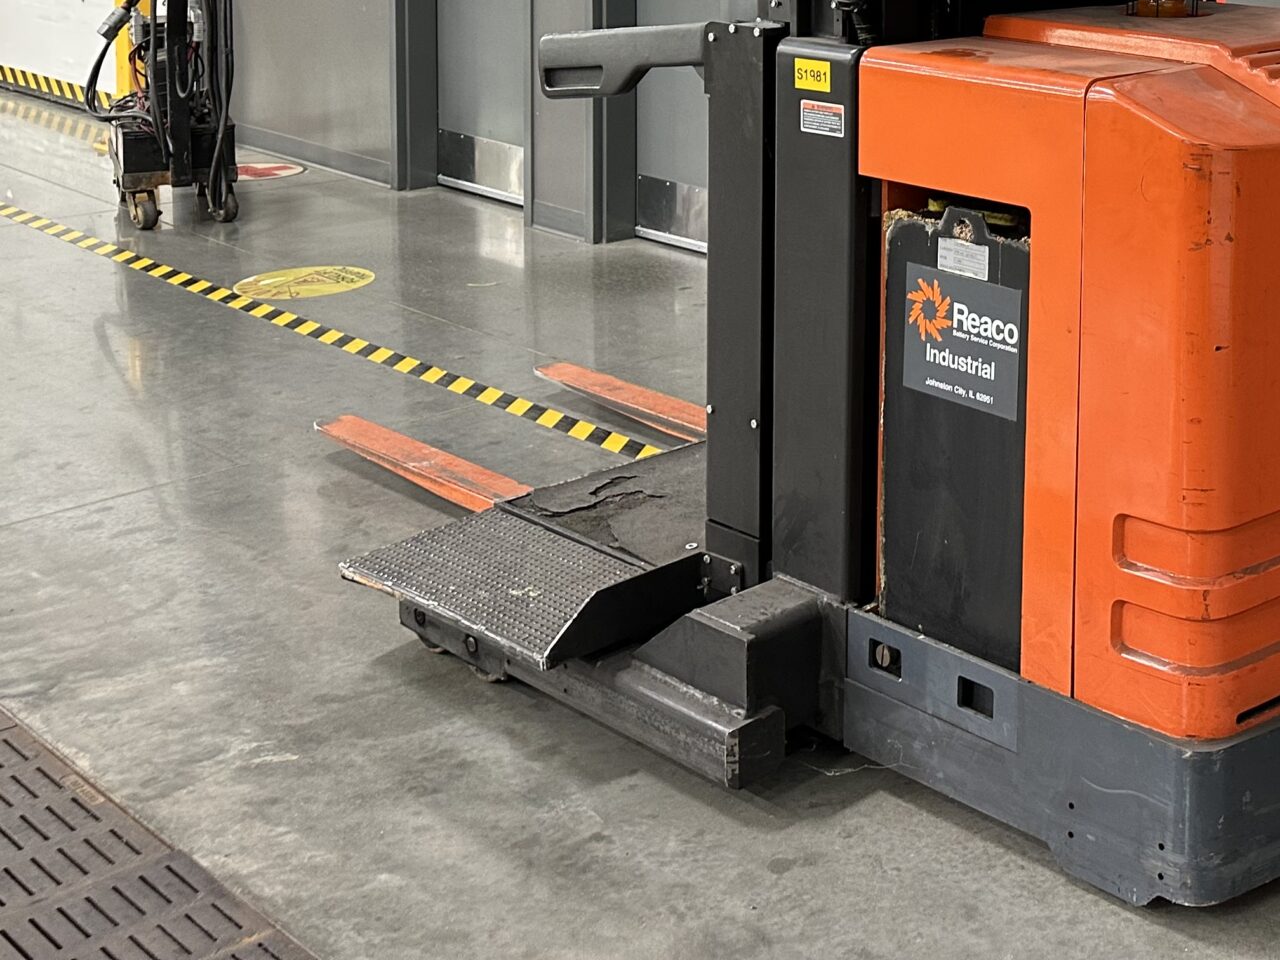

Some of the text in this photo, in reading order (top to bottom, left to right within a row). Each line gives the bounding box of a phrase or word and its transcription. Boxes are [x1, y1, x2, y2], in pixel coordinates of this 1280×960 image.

[796, 67, 828, 84] S1981
[952, 301, 1019, 345] Reaco
[925, 342, 996, 381] Industrial
